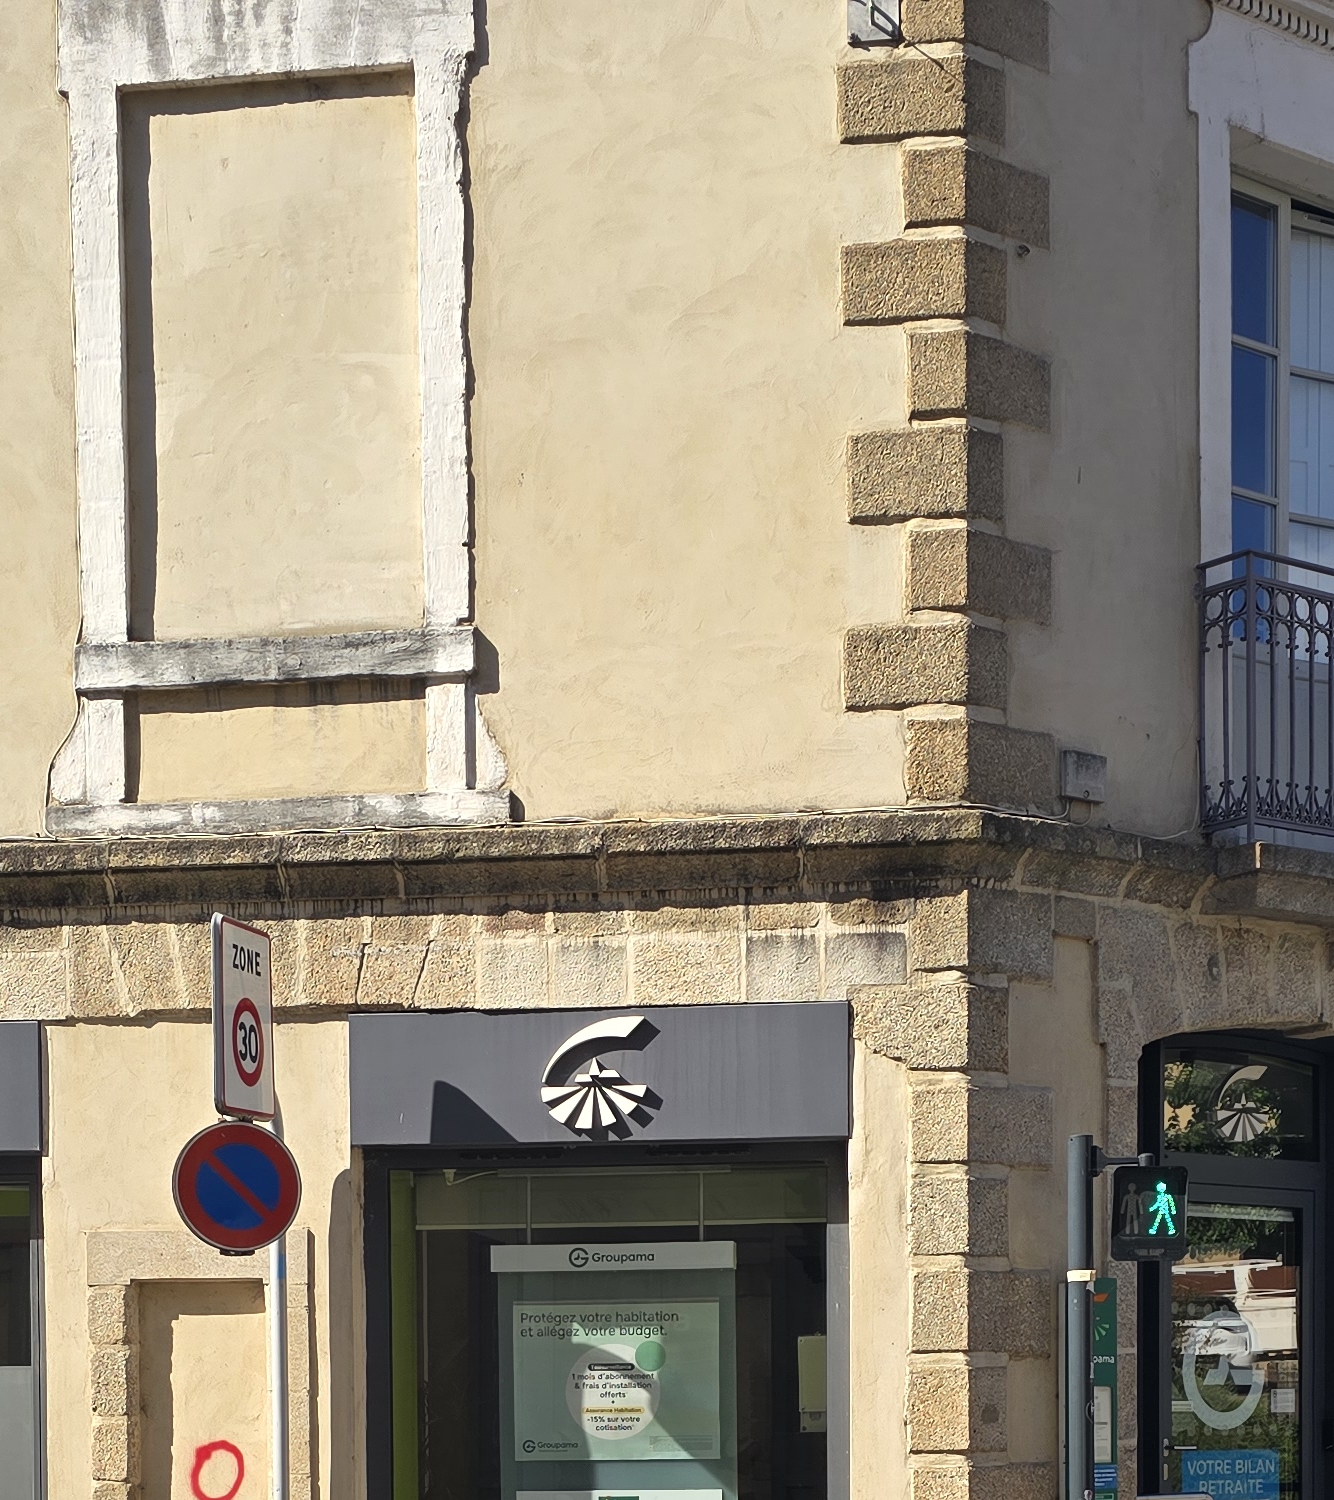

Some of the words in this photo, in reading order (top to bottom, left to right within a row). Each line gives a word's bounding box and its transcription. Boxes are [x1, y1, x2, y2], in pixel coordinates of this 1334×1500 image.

[232, 943, 261, 977] ZONE
[238, 1021, 259, 1064] 30
[591, 1252, 655, 1265] Groupama
[520, 1311, 576, 1327] Protégez
[579, 1312, 612, 1323] votre
[616, 1311, 679, 1322] habitation
[520, 1327, 533, 1337] et
[536, 1325, 579, 1339] allégez
[584, 1325, 616, 1336] votre
[619, 1324, 667, 1339] budget.
[537, 1441, 578, 1449] Groupama
[1187, 1460, 1232, 1475] VOTRE
[1235, 1459, 1275, 1474] BILAN
[1199, 1478, 1264, 1495] RETRAITE
